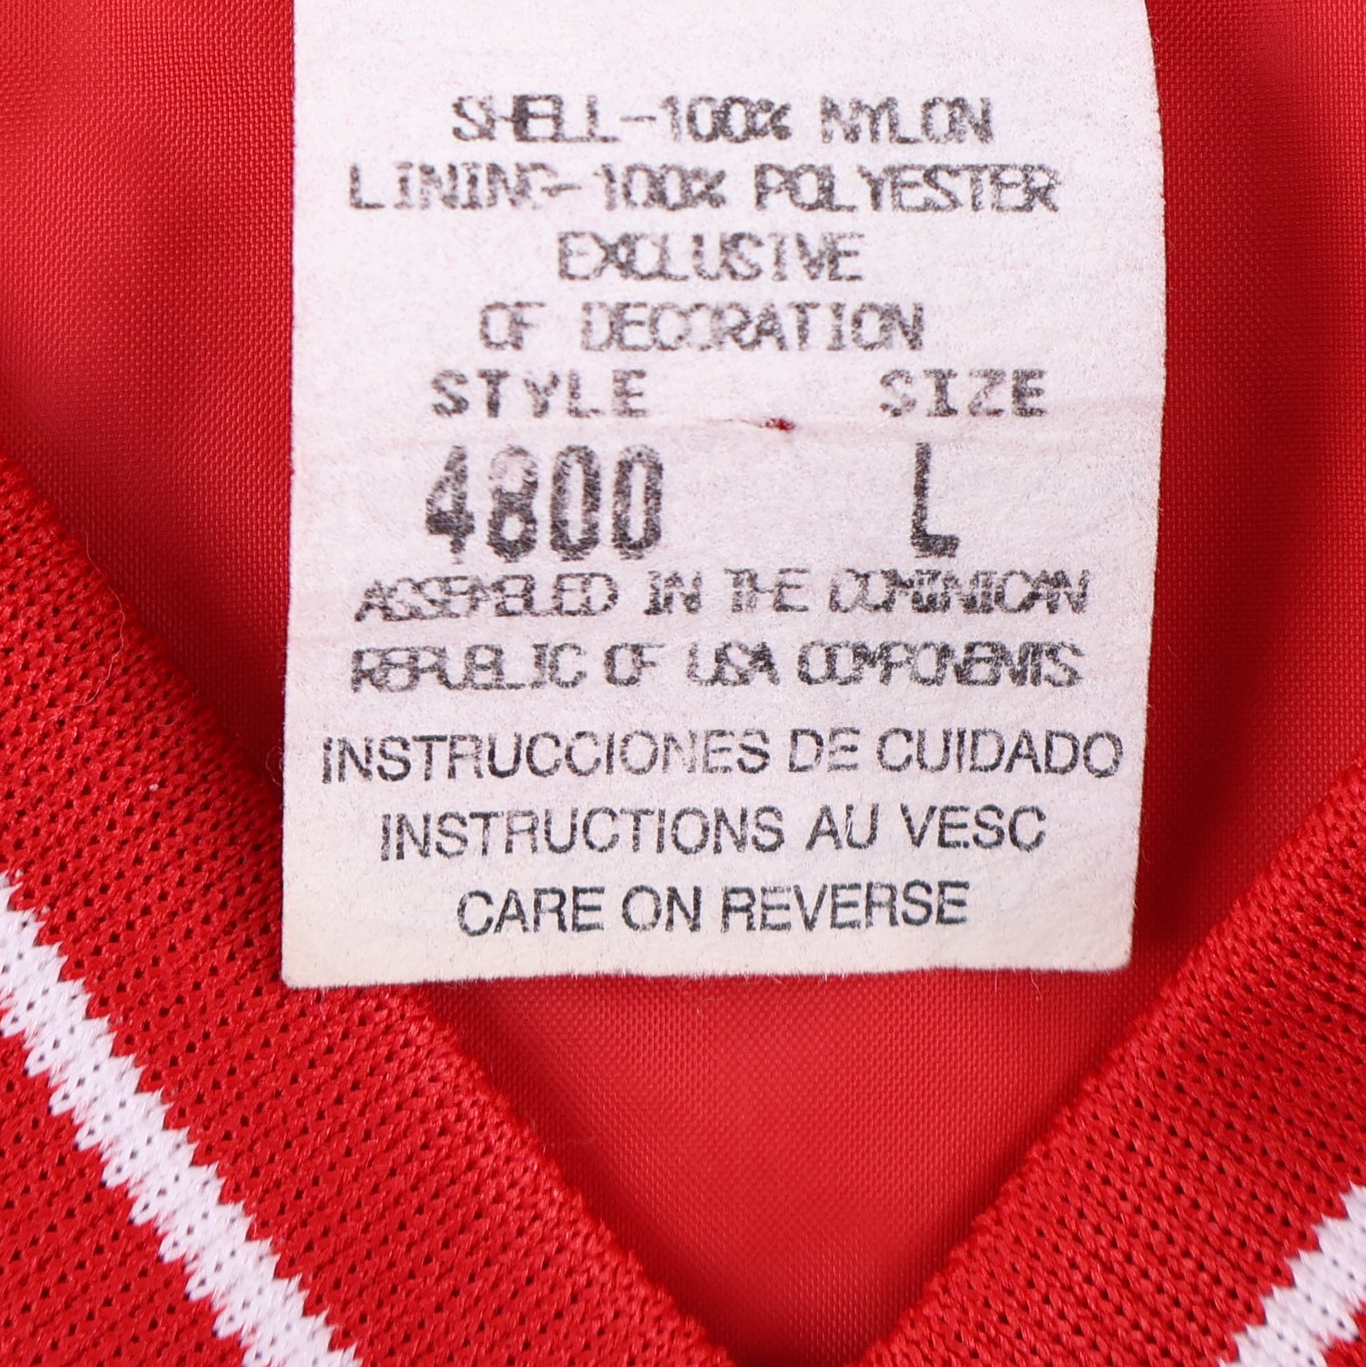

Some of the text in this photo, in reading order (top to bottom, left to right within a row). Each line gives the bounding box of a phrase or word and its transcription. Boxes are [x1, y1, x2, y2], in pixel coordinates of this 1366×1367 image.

[822, 96, 993, 143] NYLON
[755, 164, 1059, 213] POLYESTER
[558, 232, 864, 281] EXCLUSIVE
[480, 302, 924, 351] OF DECORATION
[432, 370, 646, 418] STYLE
[879, 369, 1047, 418] SIZE
[426, 445, 663, 562] 4800
[912, 442, 959, 557] L
[355, 568, 1088, 621] ASSEMBLED IN THE DOMINICAN
[351, 641, 1085, 692] REPUBLIC OF USA COMPONENTS
[322, 728, 1125, 783] INSTRUCCIONES DE CUIDADO
[381, 804, 1046, 861] INSTRUCTIONS AU VESC
[457, 881, 969, 936] CARE ON REVERSE
